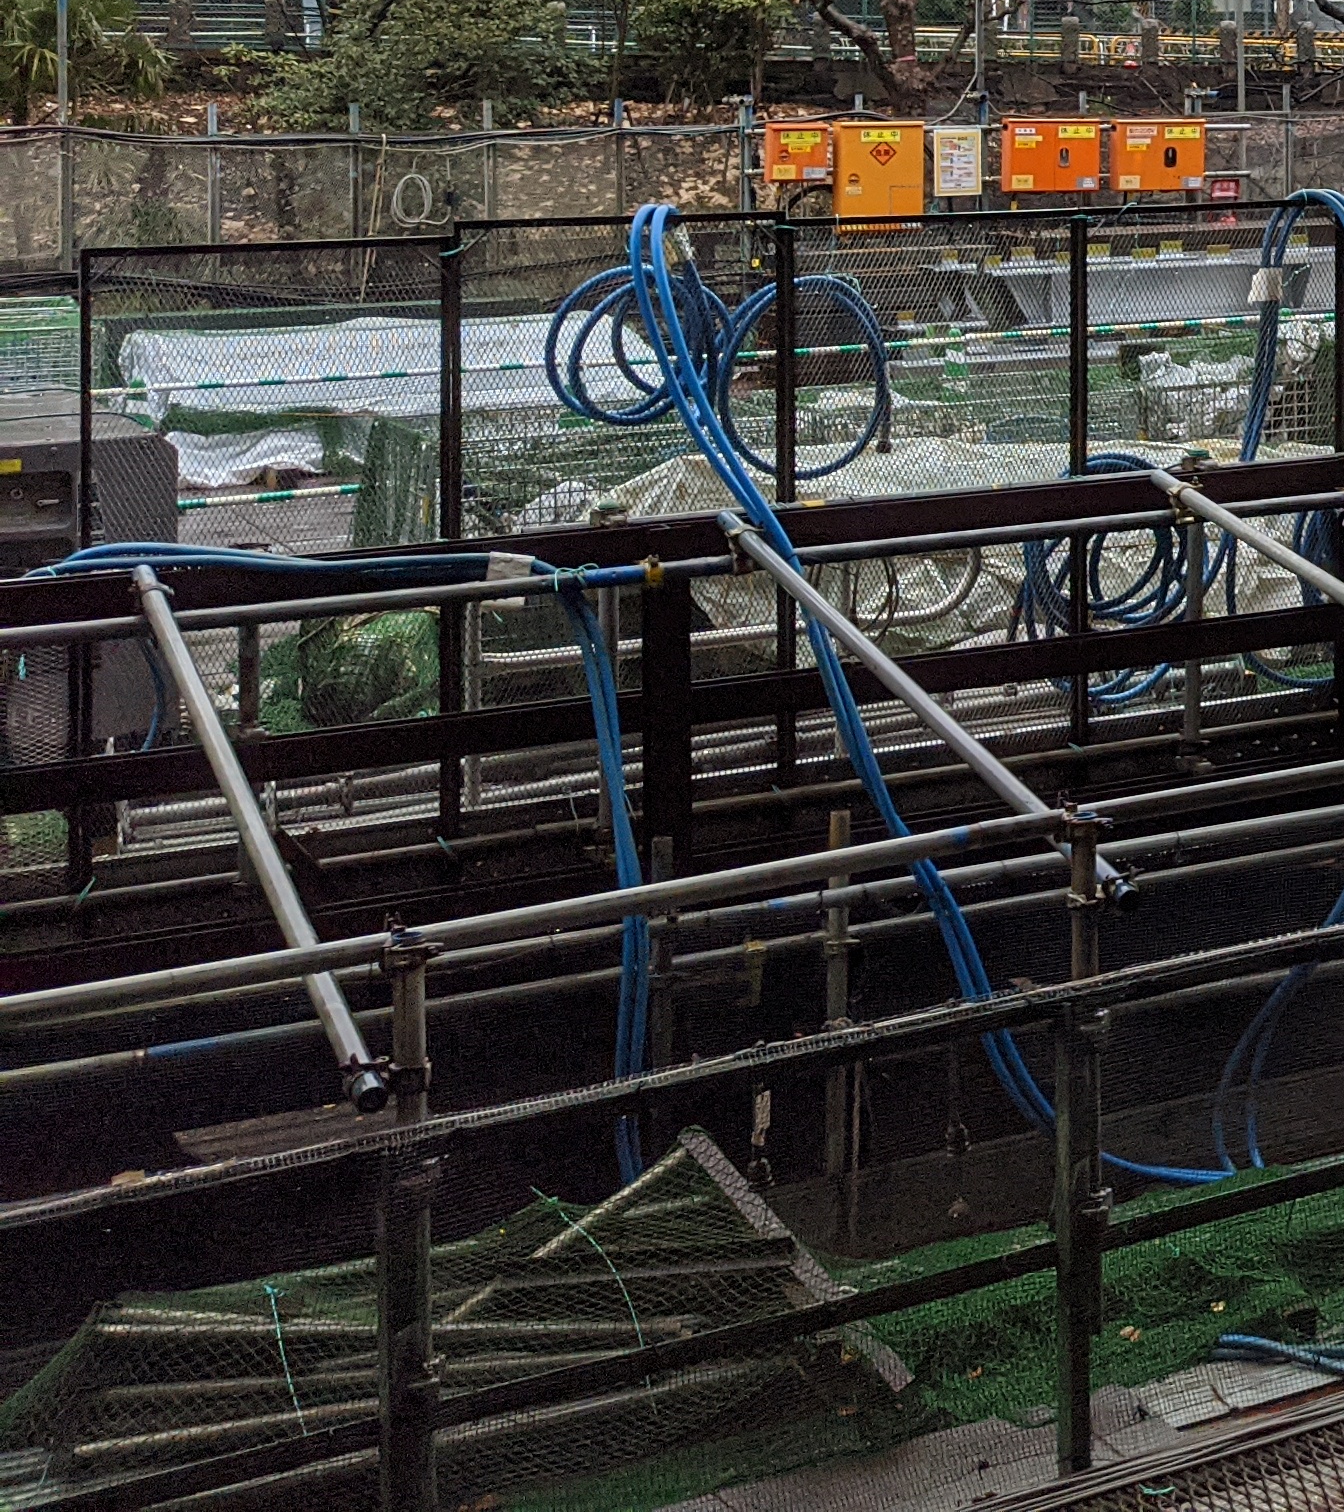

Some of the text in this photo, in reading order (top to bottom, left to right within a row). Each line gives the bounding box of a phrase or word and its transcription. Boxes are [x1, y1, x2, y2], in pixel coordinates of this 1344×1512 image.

[862, 131, 899, 139] 休止中
[1060, 127, 1094, 135] 休止中
[1166, 128, 1198, 136] 休止中
[782, 131, 820, 140] 休止中
